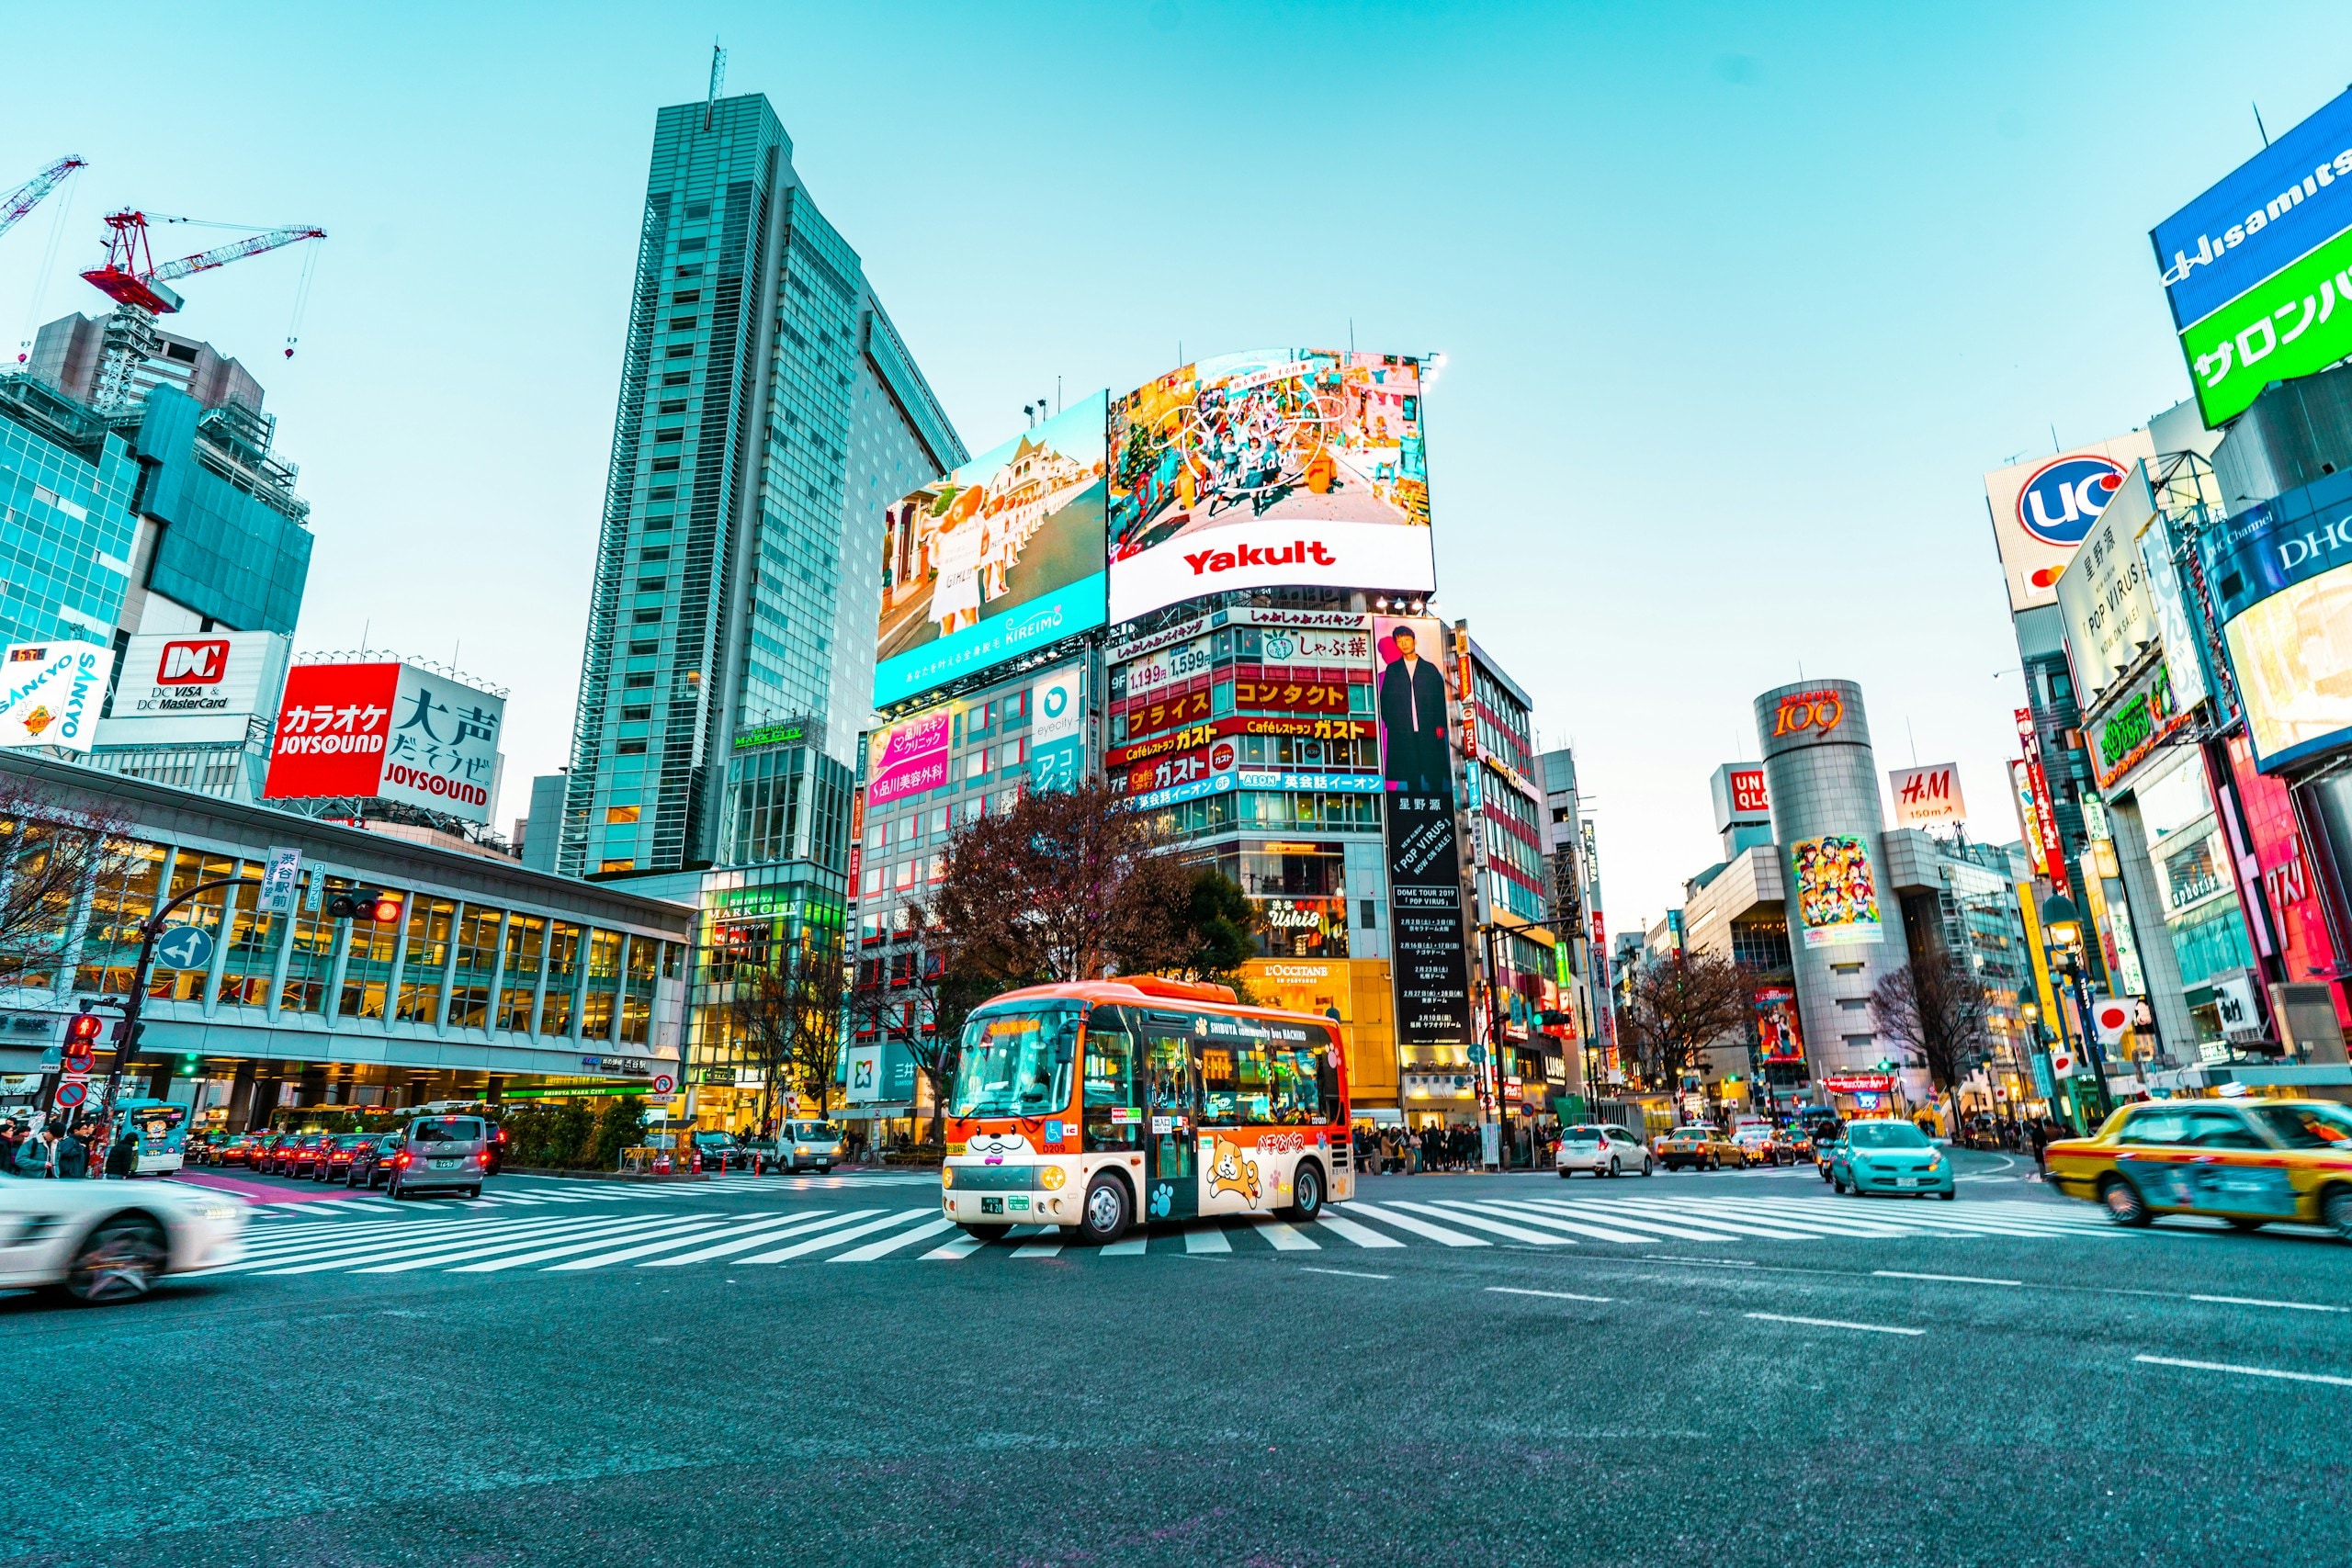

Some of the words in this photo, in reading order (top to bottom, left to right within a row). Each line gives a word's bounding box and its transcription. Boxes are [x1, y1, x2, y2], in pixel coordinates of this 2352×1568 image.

[2227, 511, 2274, 546] Channel
[1184, 540, 1336, 574] Yakult
[1005, 612, 1063, 646] KIREIMO
[1250, 610, 1365, 626] しゃぶしゃぶバイキング
[1300, 636, 1367, 658] しゃぶ葉
[2100, 636, 2114, 655] NOW
[2114, 624, 2122, 641] ON
[163, 645, 220, 678] DC
[152, 687, 172, 698] DC
[175, 686, 202, 697] VISA
[210, 686, 220, 695] &
[1111, 674, 1126, 690] 9F
[62, 652, 99, 739] SANKYO
[137, 699, 157, 710] DC
[159, 697, 229, 710] MasterCard
[1237, 683, 1344, 706] コンタクト
[283, 705, 387, 733] カラオケ
[395, 687, 497, 746] 大声
[1130, 692, 1209, 732] プライス
[1772, 698, 1844, 739] 109
[735, 733, 769, 745] MARK
[772, 728, 801, 738] CITY
[904, 717, 945, 739] 品川スキン
[1037, 717, 1073, 738] eyecity
[1176, 724, 1217, 751] ガスト
[1314, 719, 1365, 739] ガスト
[277, 735, 383, 754] JOYSOUND
[903, 733, 940, 753] クリニック
[1215, 754, 1233, 764] ガスト
[879, 765, 944, 798] 品川美容外科
[1131, 769, 1153, 784] Café
[1155, 756, 1205, 789] ガスト
[1243, 774, 1277, 786] AEON
[1284, 774, 1381, 790] 英会話イーオン
[384, 763, 487, 807] JOYSOUND
[1110, 776, 1128, 794] 7F
[1139, 782, 1212, 807] 英会話イーオン
[1216, 778, 1228, 788] 6F
[1900, 770, 1950, 805] H&M
[1399, 797, 1442, 811] 星野源
[1910, 809, 1941, 819] 150m
[1413, 857, 1429, 875] NOW
[1427, 850, 1438, 861] ON
[1434, 833, 1453, 853] SALE!
[266, 859, 279, 885] Shibuya
[272, 852, 296, 908] 渋谷駅前
[729, 897, 775, 907] SHIBUYA
[1396, 888, 1418, 897] DOME
[1419, 888, 1437, 897] TOUR
[707, 908, 753, 919] MARK
[760, 903, 799, 915] CITY
[1265, 964, 1329, 976] L'OCCITANE
[1210, 1021, 1238, 1035] SHIBUYA
[1238, 1026, 1271, 1041] community
[1271, 1027, 1282, 1039] bus
[1282, 1029, 1306, 1041] HACHIKO
[1545, 1055, 1566, 1078] LUSH
[1154, 1118, 1170, 1127] 出入口
[1043, 1145, 1066, 1154] D209
[1257, 1132, 1306, 1155] ハチ公バス
